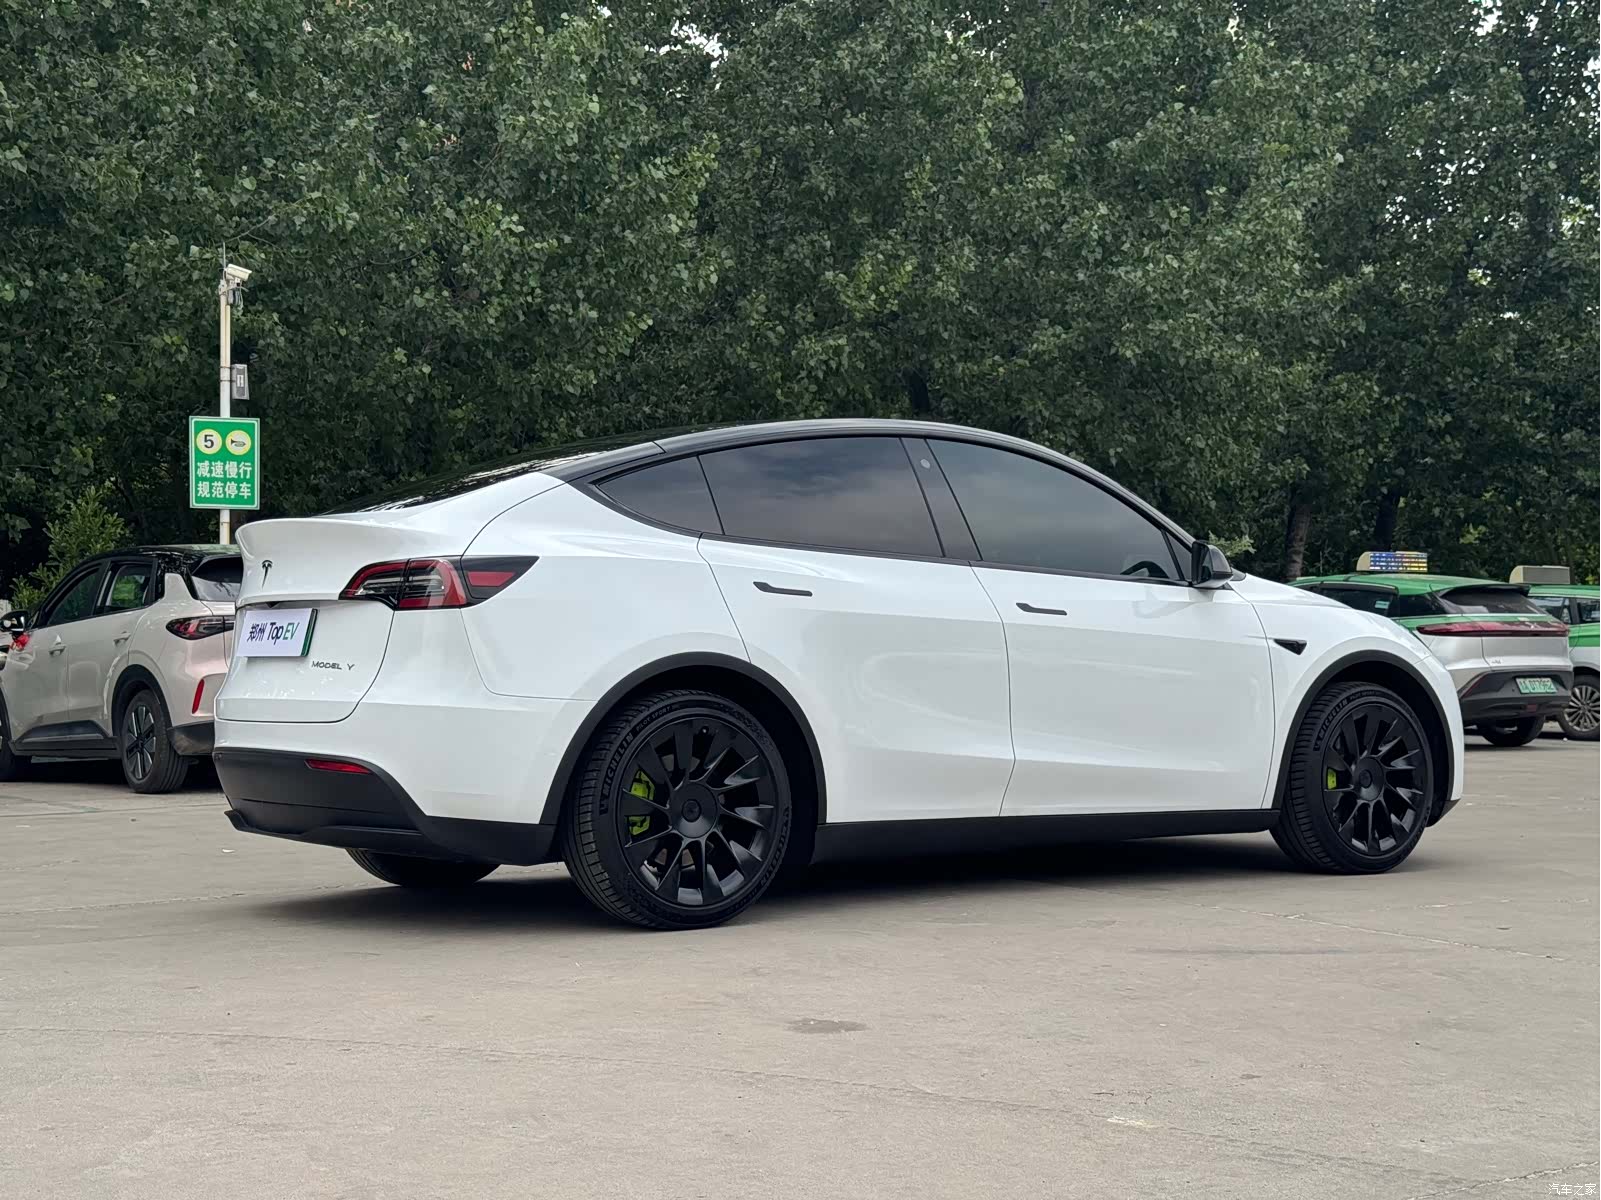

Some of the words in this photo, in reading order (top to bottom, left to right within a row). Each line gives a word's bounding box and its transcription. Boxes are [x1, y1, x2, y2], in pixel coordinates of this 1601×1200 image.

[204, 434, 214, 449] 5
[197, 461, 252, 479] 减速慢行
[197, 481, 252, 499] 规范停车
[247, 622, 267, 642] 郑州
[311, 660, 342, 670] MODEL
[347, 663, 355, 671] Y
[1319, 699, 1348, 738] MICHELIN
[602, 732, 634, 797] MICHELIN
[636, 716, 652, 732] PILOT
[652, 706, 672, 719] SPORT
